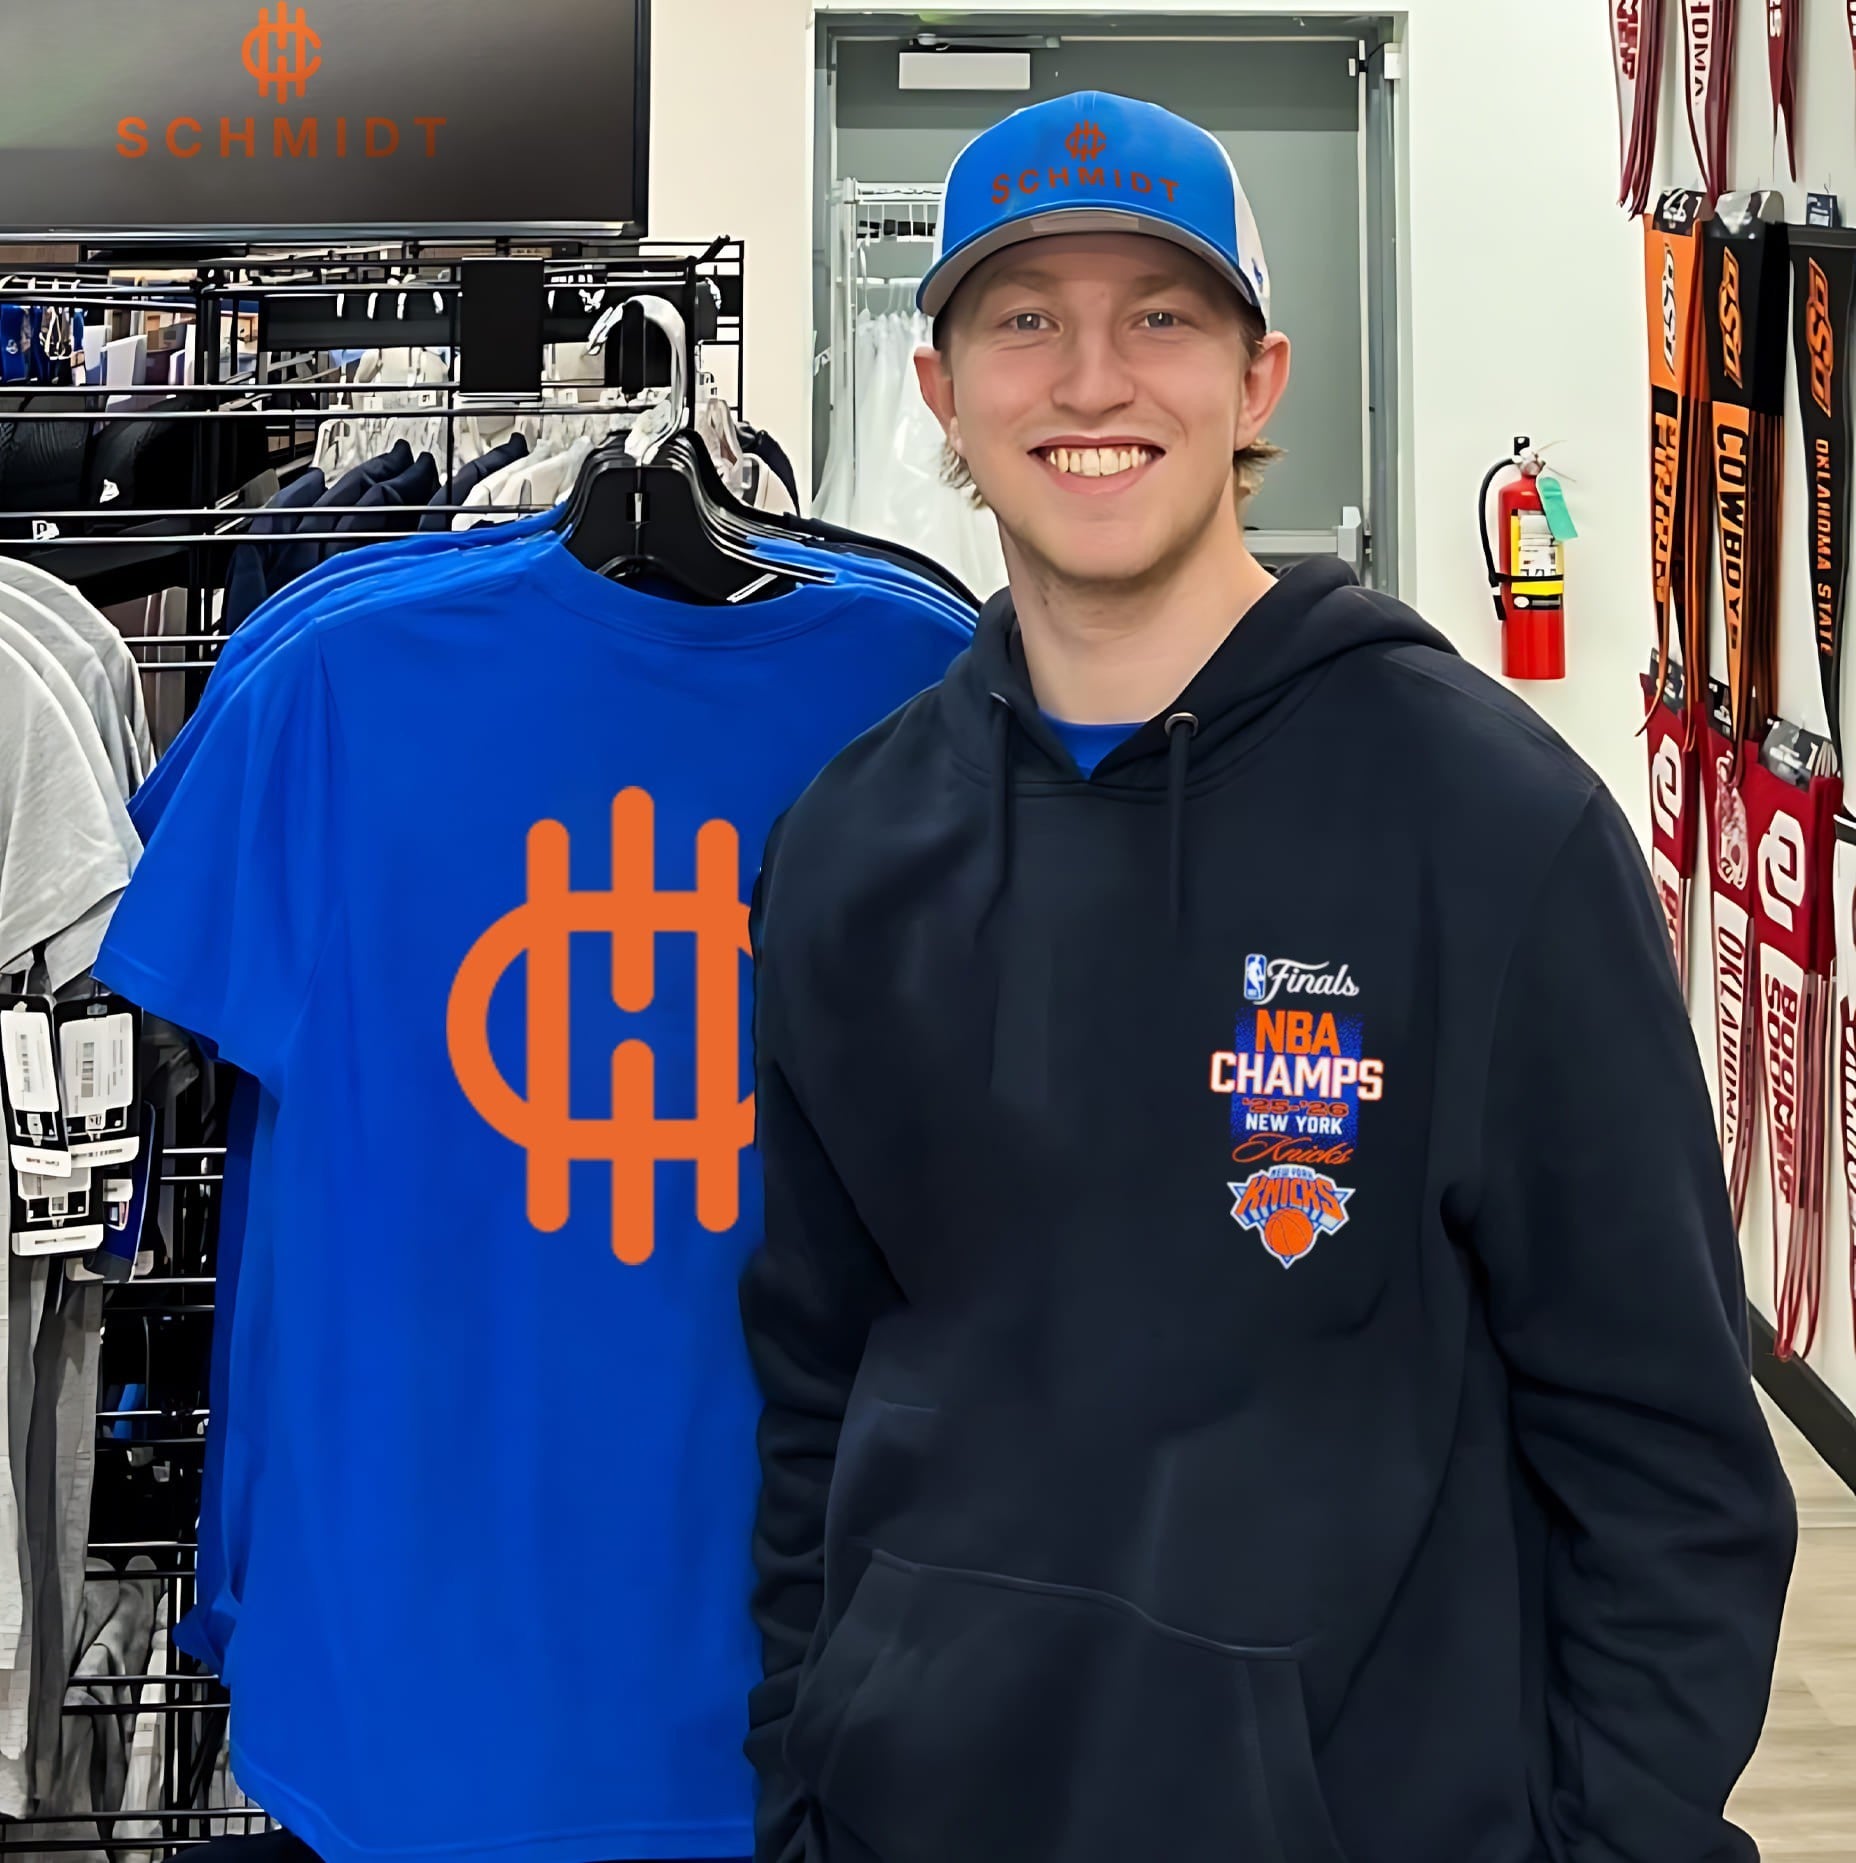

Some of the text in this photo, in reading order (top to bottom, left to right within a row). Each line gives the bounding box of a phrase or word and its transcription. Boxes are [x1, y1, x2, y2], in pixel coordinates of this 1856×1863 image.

[116, 117, 447, 158] SCHMIDT
[992, 167, 1179, 204] SCHMIDT
[1815, 438, 1831, 570] OKLAHOMA
[1717, 424, 1749, 649] COWBOY
[1253, 958, 1359, 1005] Finals
[1255, 1009, 1341, 1056] NBA
[1718, 926, 1744, 1143] OKLAHOMA
[1210, 1050, 1384, 1101] CHAMPS
[1245, 1113, 1343, 1135] NEW YORK
[1232, 1132, 1354, 1165] Knicks
[1235, 1175, 1345, 1221] KNICKS
